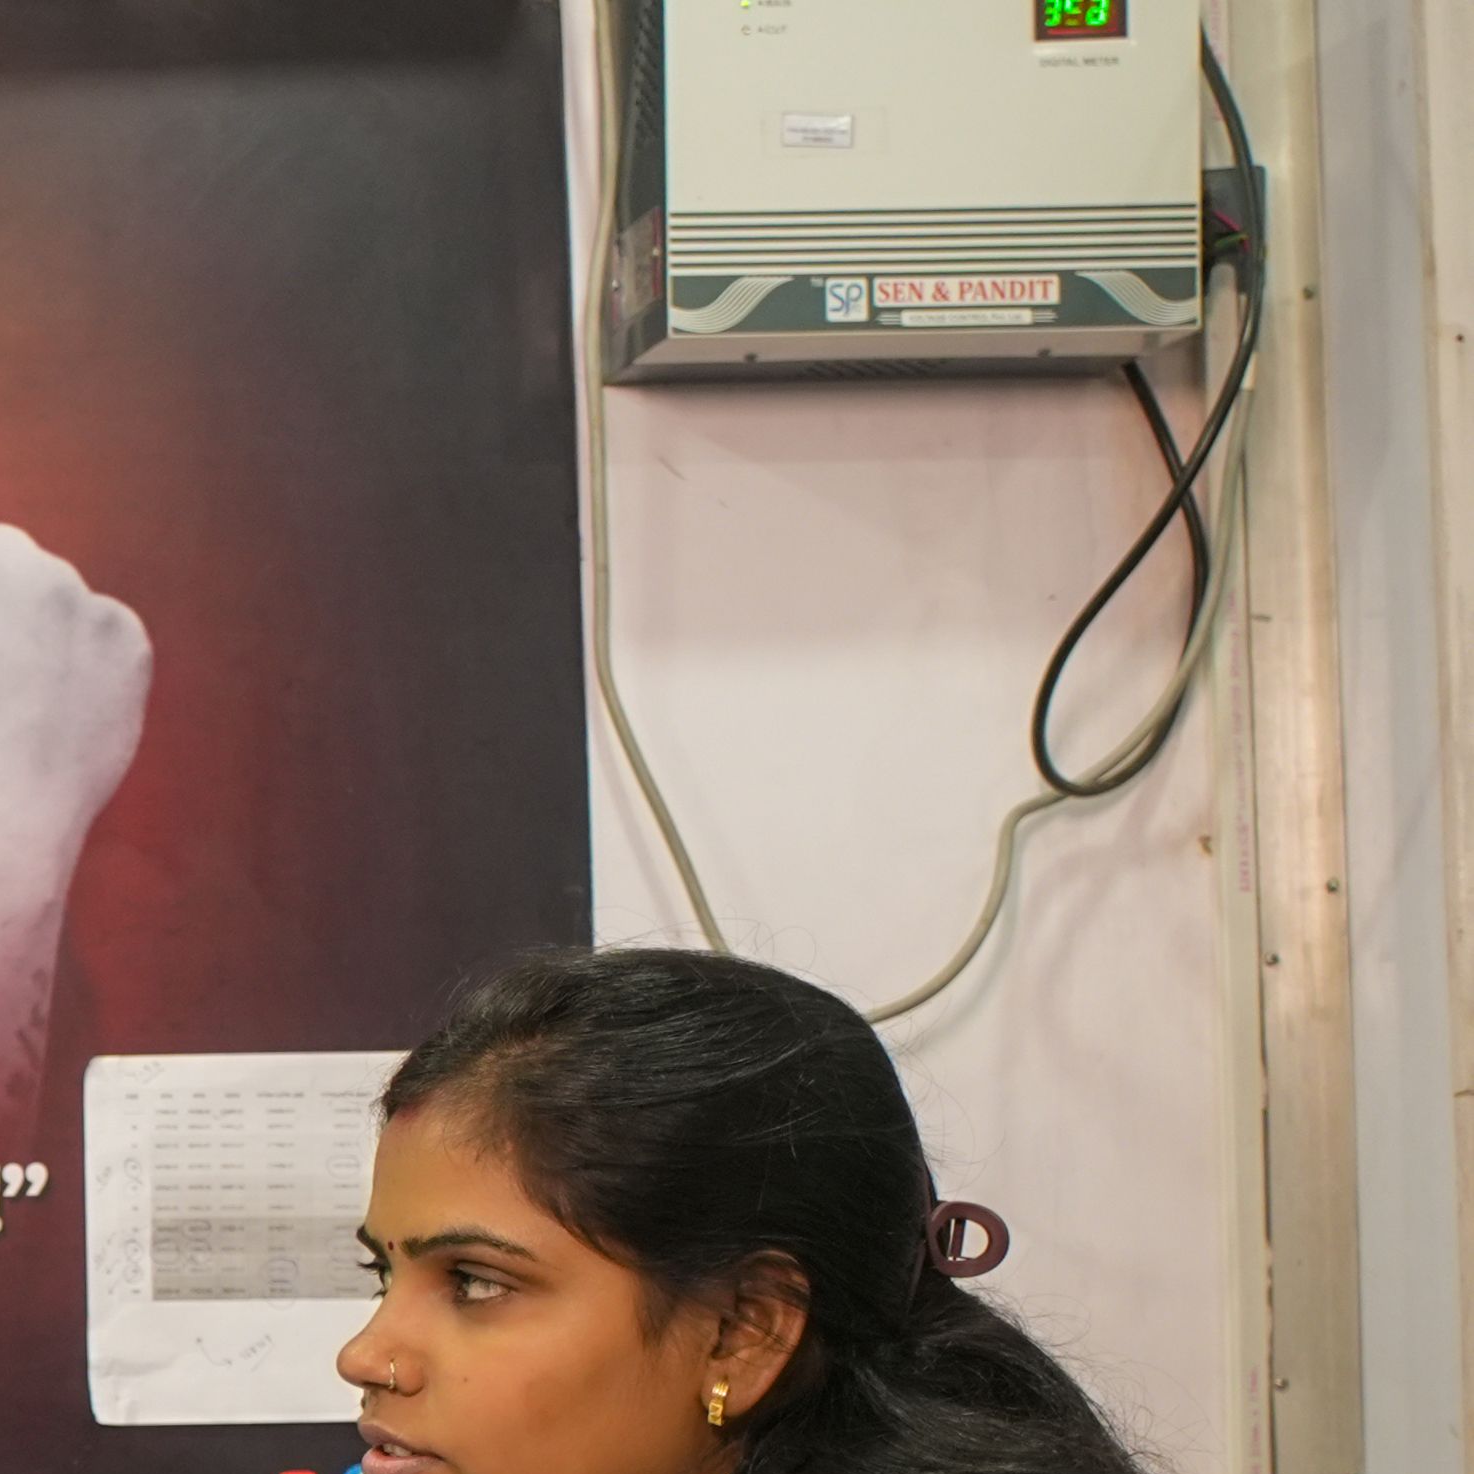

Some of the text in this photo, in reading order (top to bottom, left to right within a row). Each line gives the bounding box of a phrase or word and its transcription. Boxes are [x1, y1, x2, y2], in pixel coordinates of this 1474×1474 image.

[877, 280, 1054, 301] SEN & PANDIT
